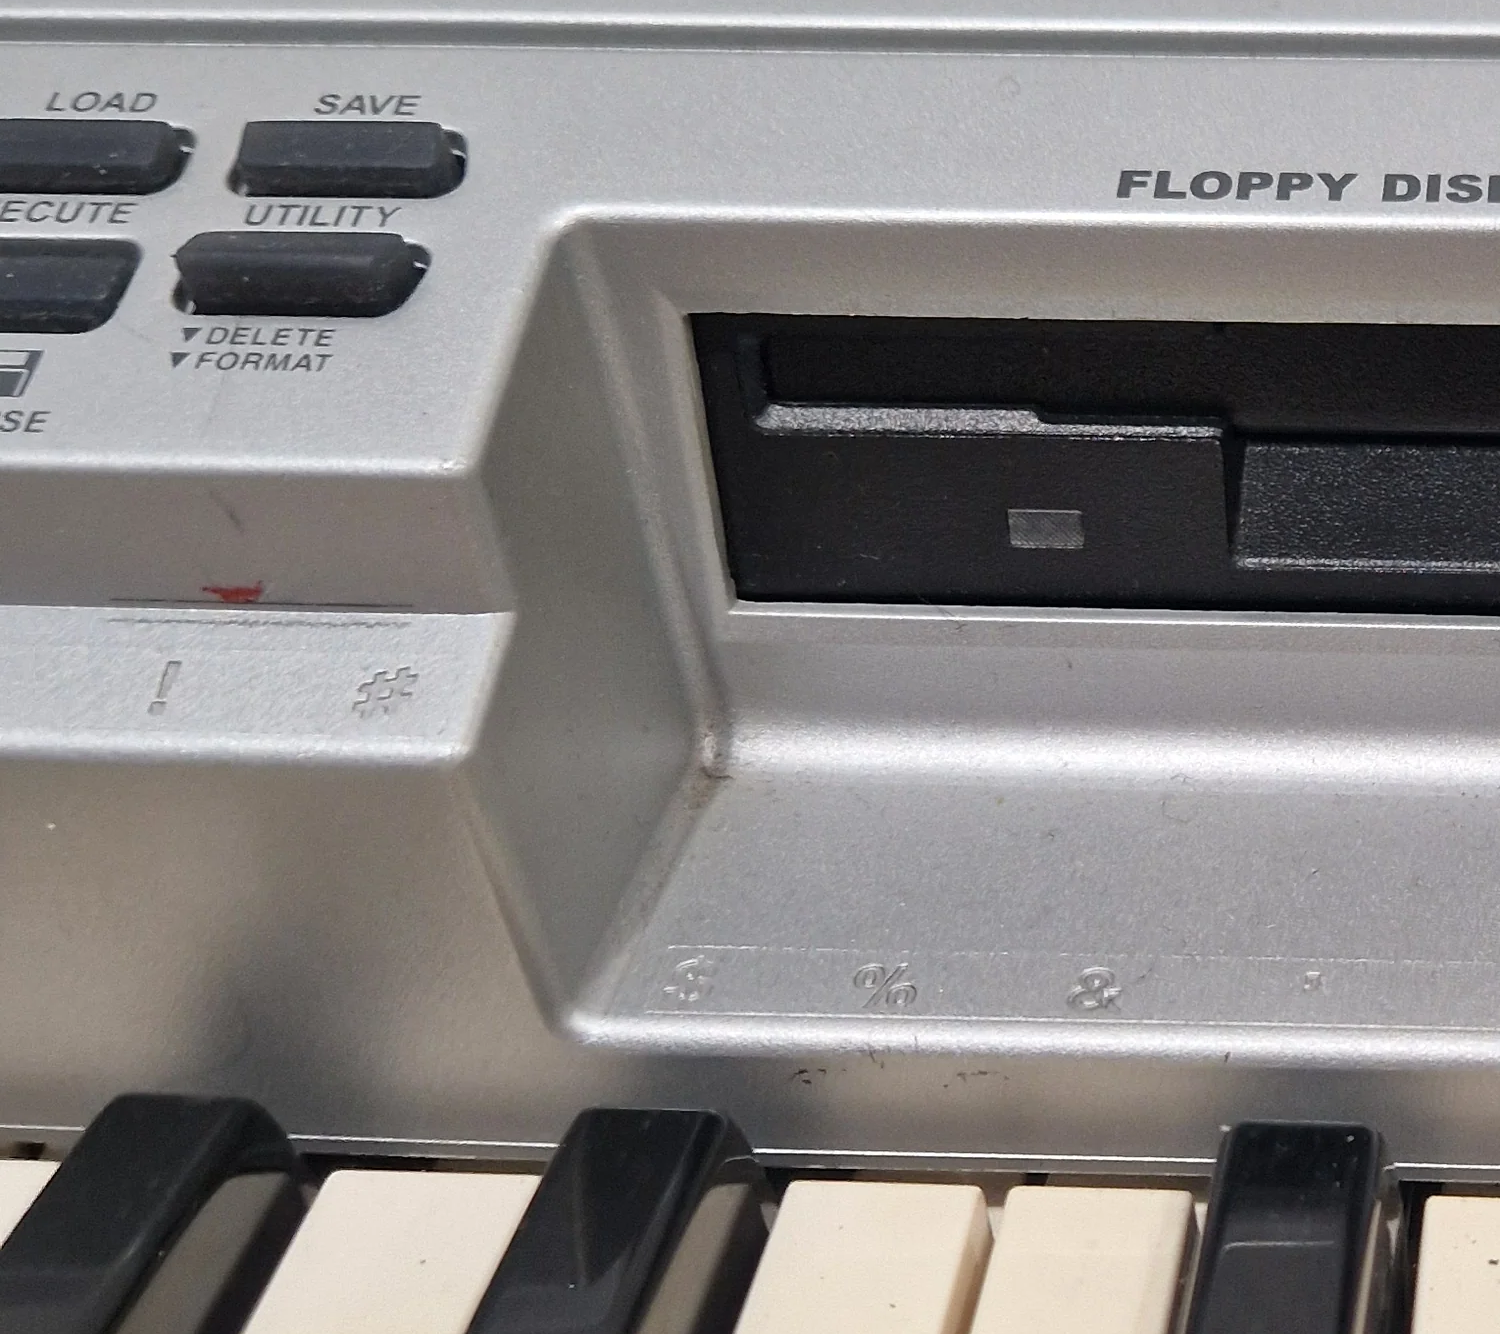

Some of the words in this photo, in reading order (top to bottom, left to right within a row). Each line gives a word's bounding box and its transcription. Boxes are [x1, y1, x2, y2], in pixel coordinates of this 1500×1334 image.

[45, 91, 158, 113] LOAD
[314, 94, 422, 116] SAVE
[1116, 170, 1358, 202] FLOPPY
[0, 200, 138, 223] ECUTE
[244, 204, 401, 227] UTILITY
[206, 326, 336, 347] DELETE
[194, 352, 334, 372] FORMAT
